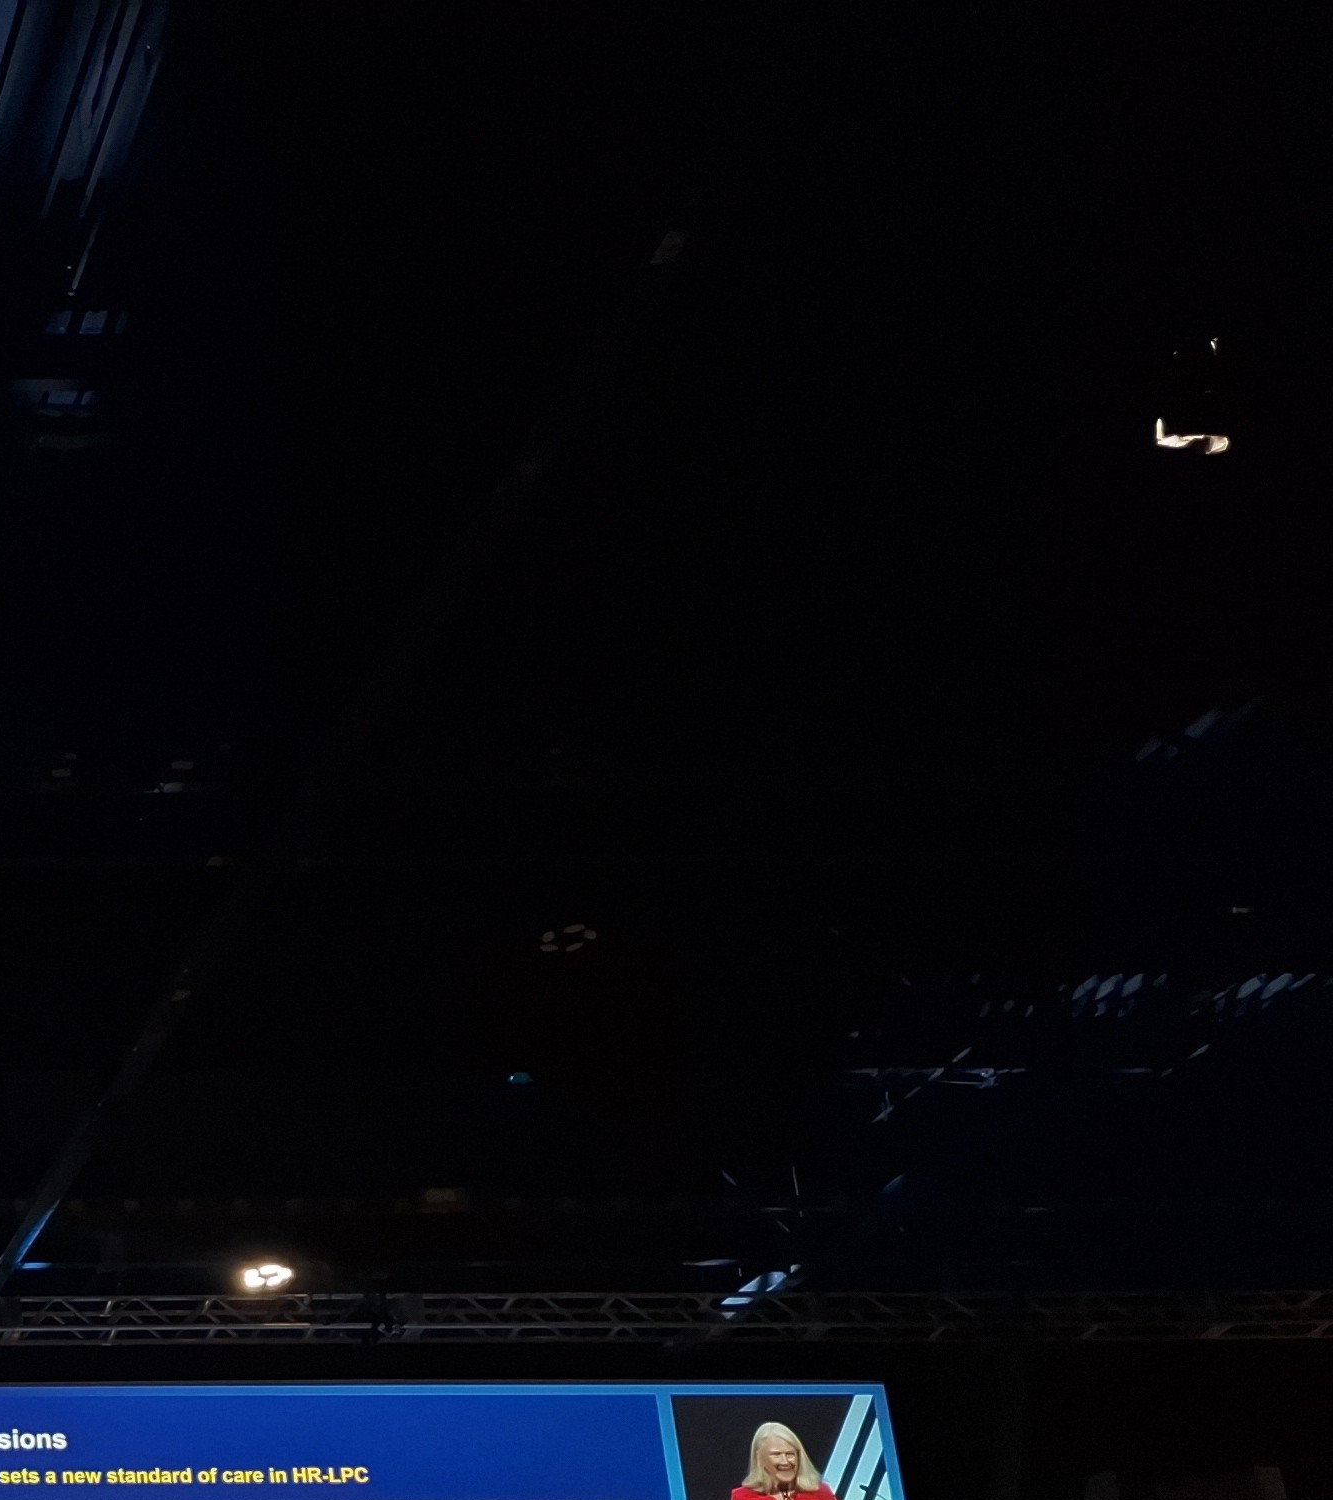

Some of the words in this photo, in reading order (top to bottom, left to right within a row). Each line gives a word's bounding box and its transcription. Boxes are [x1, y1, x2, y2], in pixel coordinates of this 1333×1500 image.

[0, 1467, 39, 1485] sets
[46, 1472, 57, 1484] a
[62, 1467, 101, 1485] new
[106, 1467, 193, 1485] standard
[197, 1467, 217, 1485] of
[222, 1467, 264, 1485] care
[269, 1467, 287, 1485] in
[292, 1467, 369, 1485] HR-LPC
